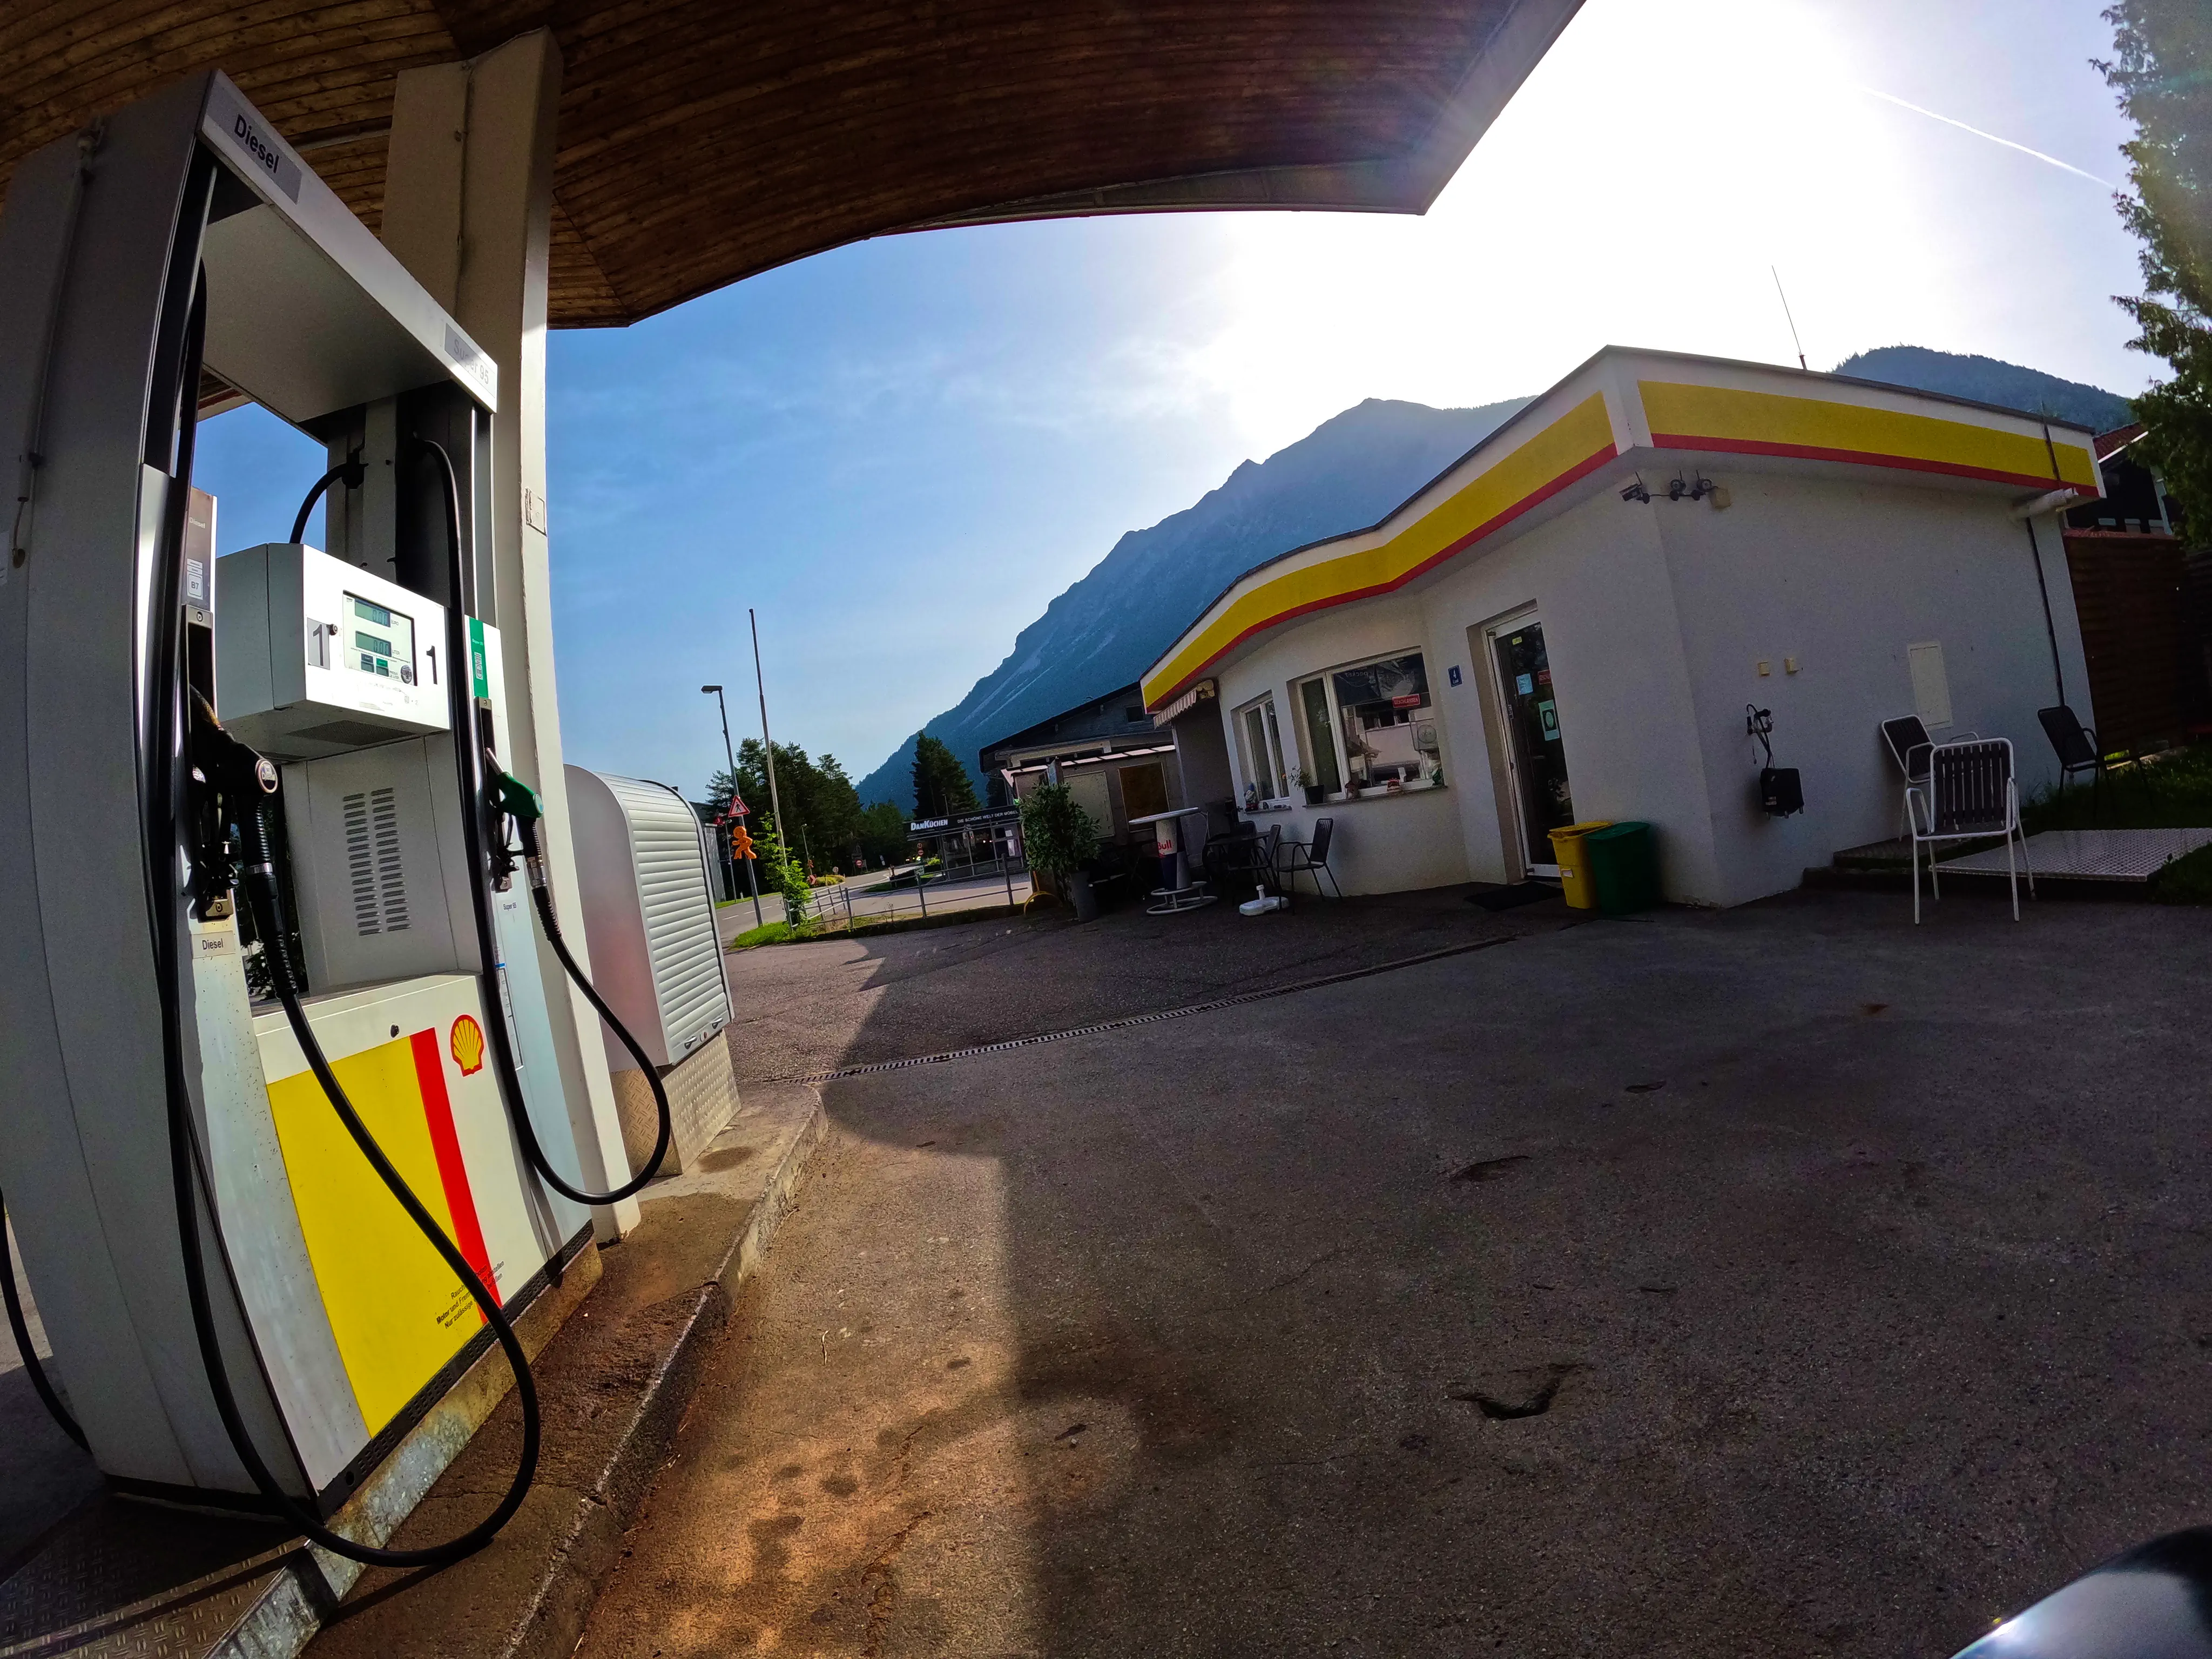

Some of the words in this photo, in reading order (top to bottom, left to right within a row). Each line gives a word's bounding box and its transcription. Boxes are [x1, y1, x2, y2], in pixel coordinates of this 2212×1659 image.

[234, 113, 280, 174] Diesel
[480, 365, 489, 385] 95
[189, 517, 206, 529] Diesel
[191, 581, 199, 590] B7
[313, 623, 324, 666] 1
[426, 645, 438, 685] 1
[1157, 839, 1172, 850] Bull
[201, 938, 224, 950] Diesel
[436, 1309, 450, 1325] Motor
[449, 1301, 459, 1313] und
[444, 1319, 454, 1329] Nur
[453, 1300, 474, 1322] zulässige
